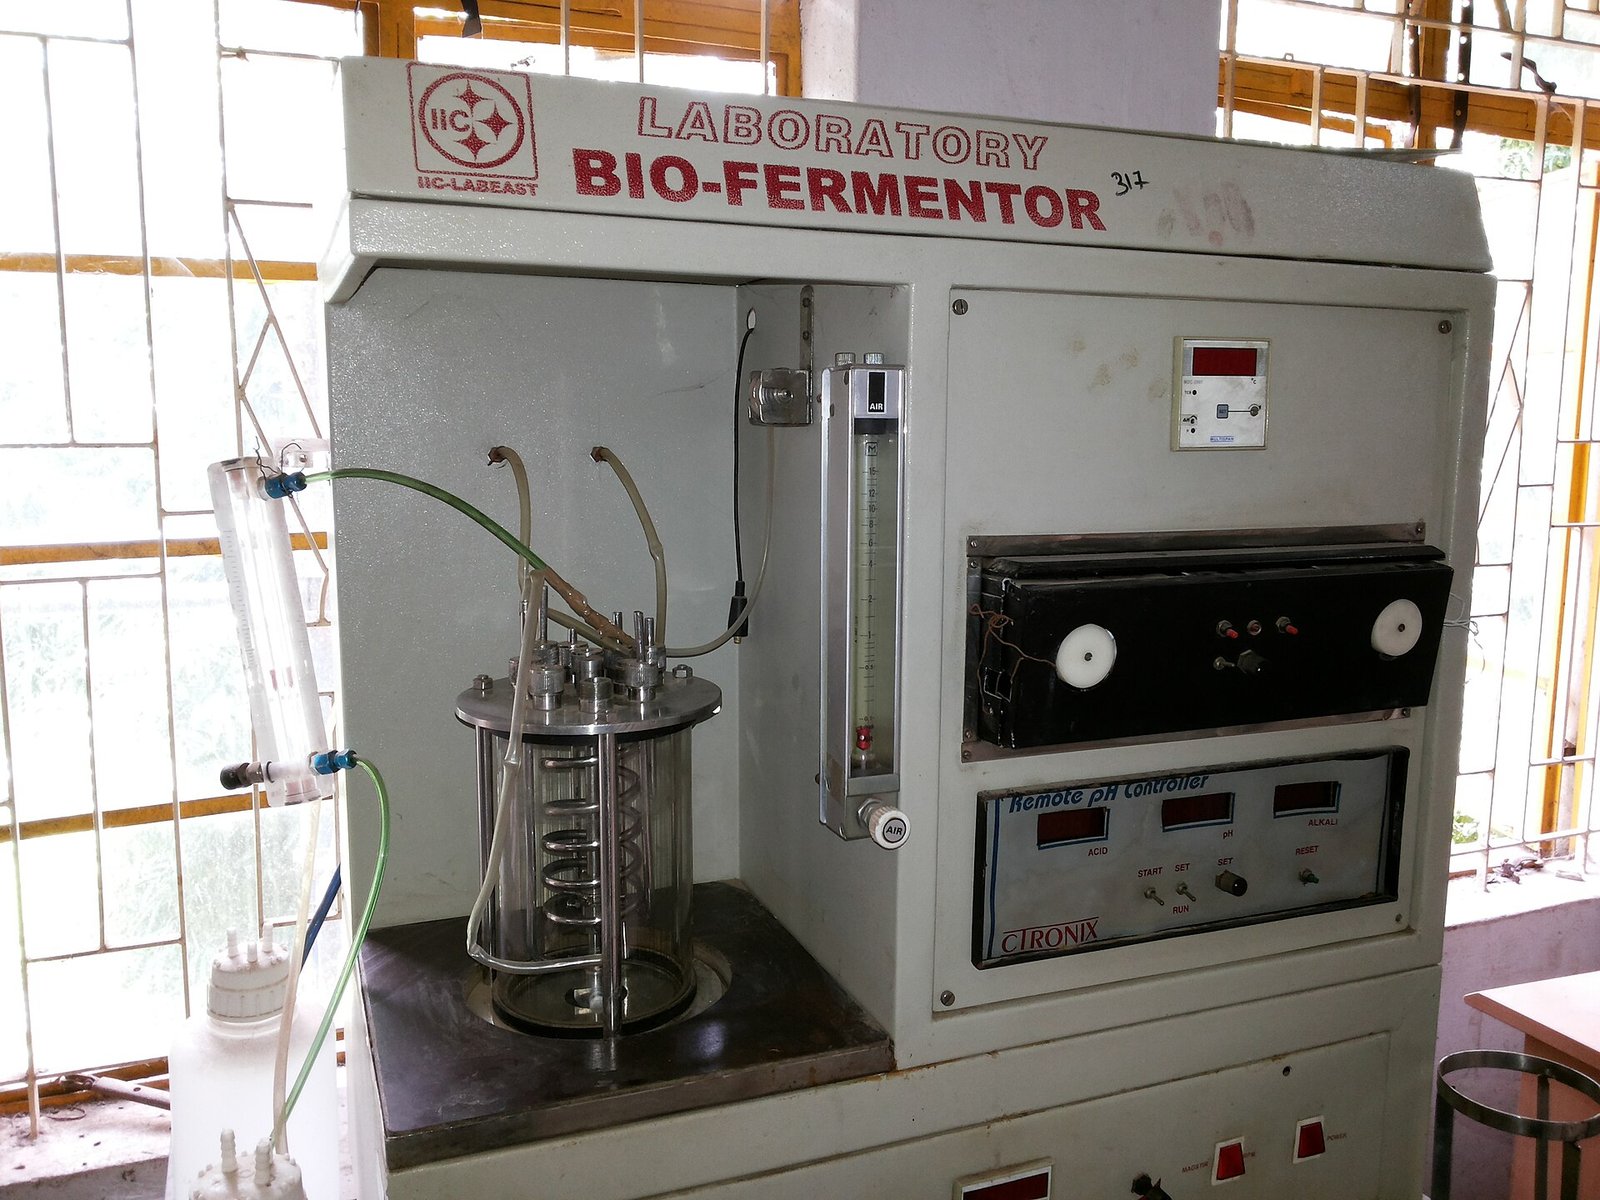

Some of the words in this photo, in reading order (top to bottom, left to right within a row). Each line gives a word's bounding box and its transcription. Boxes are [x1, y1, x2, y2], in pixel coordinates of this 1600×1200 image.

[430, 107, 471, 133] IIC
[637, 96, 1048, 171] LABORATORY
[417, 175, 539, 196] IIC-LABEAST
[1110, 170, 1150, 197] 317
[572, 147, 1107, 232] BIO-FERMENTOR
[869, 402, 884, 411] AIR
[868, 490, 876, 498] 12
[868, 504, 876, 513] 10
[1009, 788, 1083, 813] Remote
[1087, 784, 1119, 807] pH
[1124, 775, 1209, 799] Controller
[1308, 818, 1339, 827] ALKALI
[885, 823, 903, 836] AIR
[1222, 829, 1234, 839] pH
[1087, 847, 1108, 857] ACID
[1295, 845, 1319, 856] RESET
[1217, 857, 1234, 866] SET
[1137, 867, 1163, 877] START
[1174, 863, 1190, 872] SET
[1172, 905, 1190, 914] RUN
